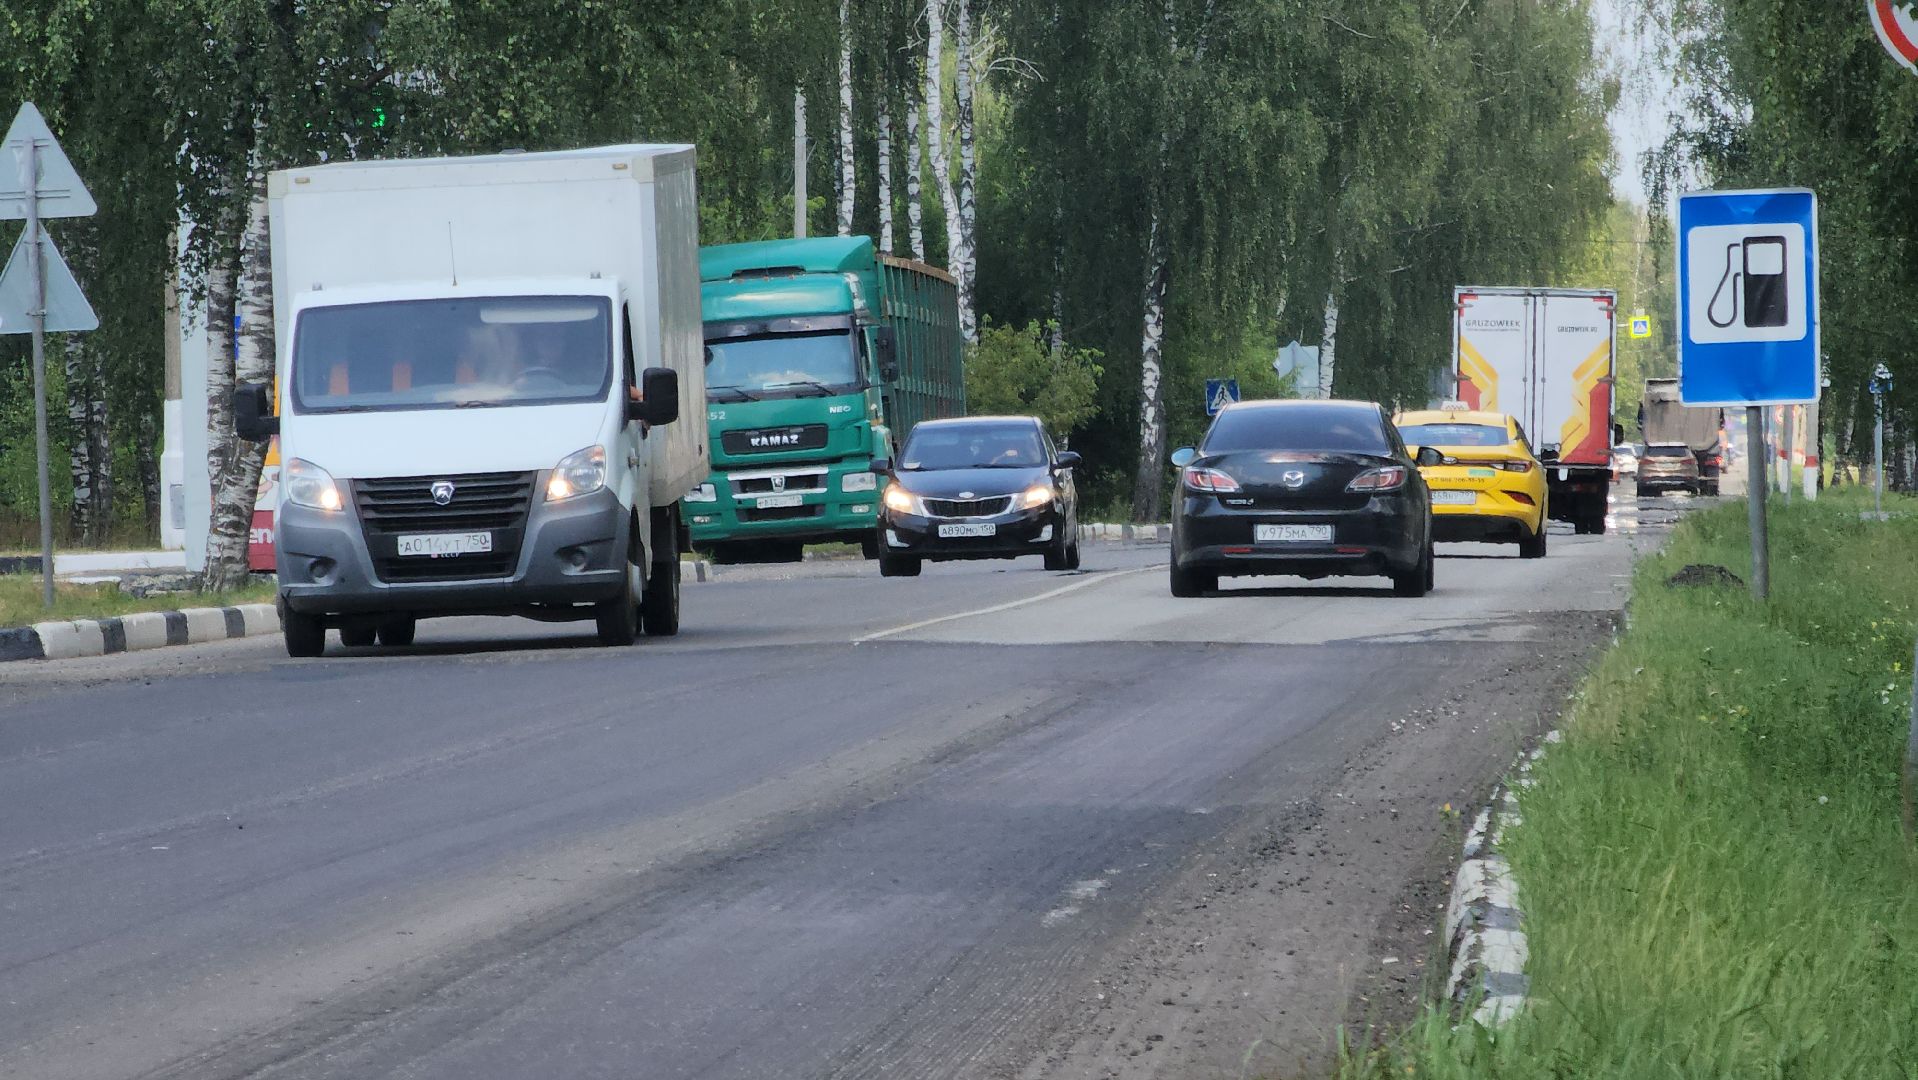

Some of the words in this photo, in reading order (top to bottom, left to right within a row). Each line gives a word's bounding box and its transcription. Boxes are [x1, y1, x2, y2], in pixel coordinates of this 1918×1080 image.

[829, 405, 851, 414] NEO
[707, 411, 726, 420] 52
[750, 434, 799, 447] KAMAZ
